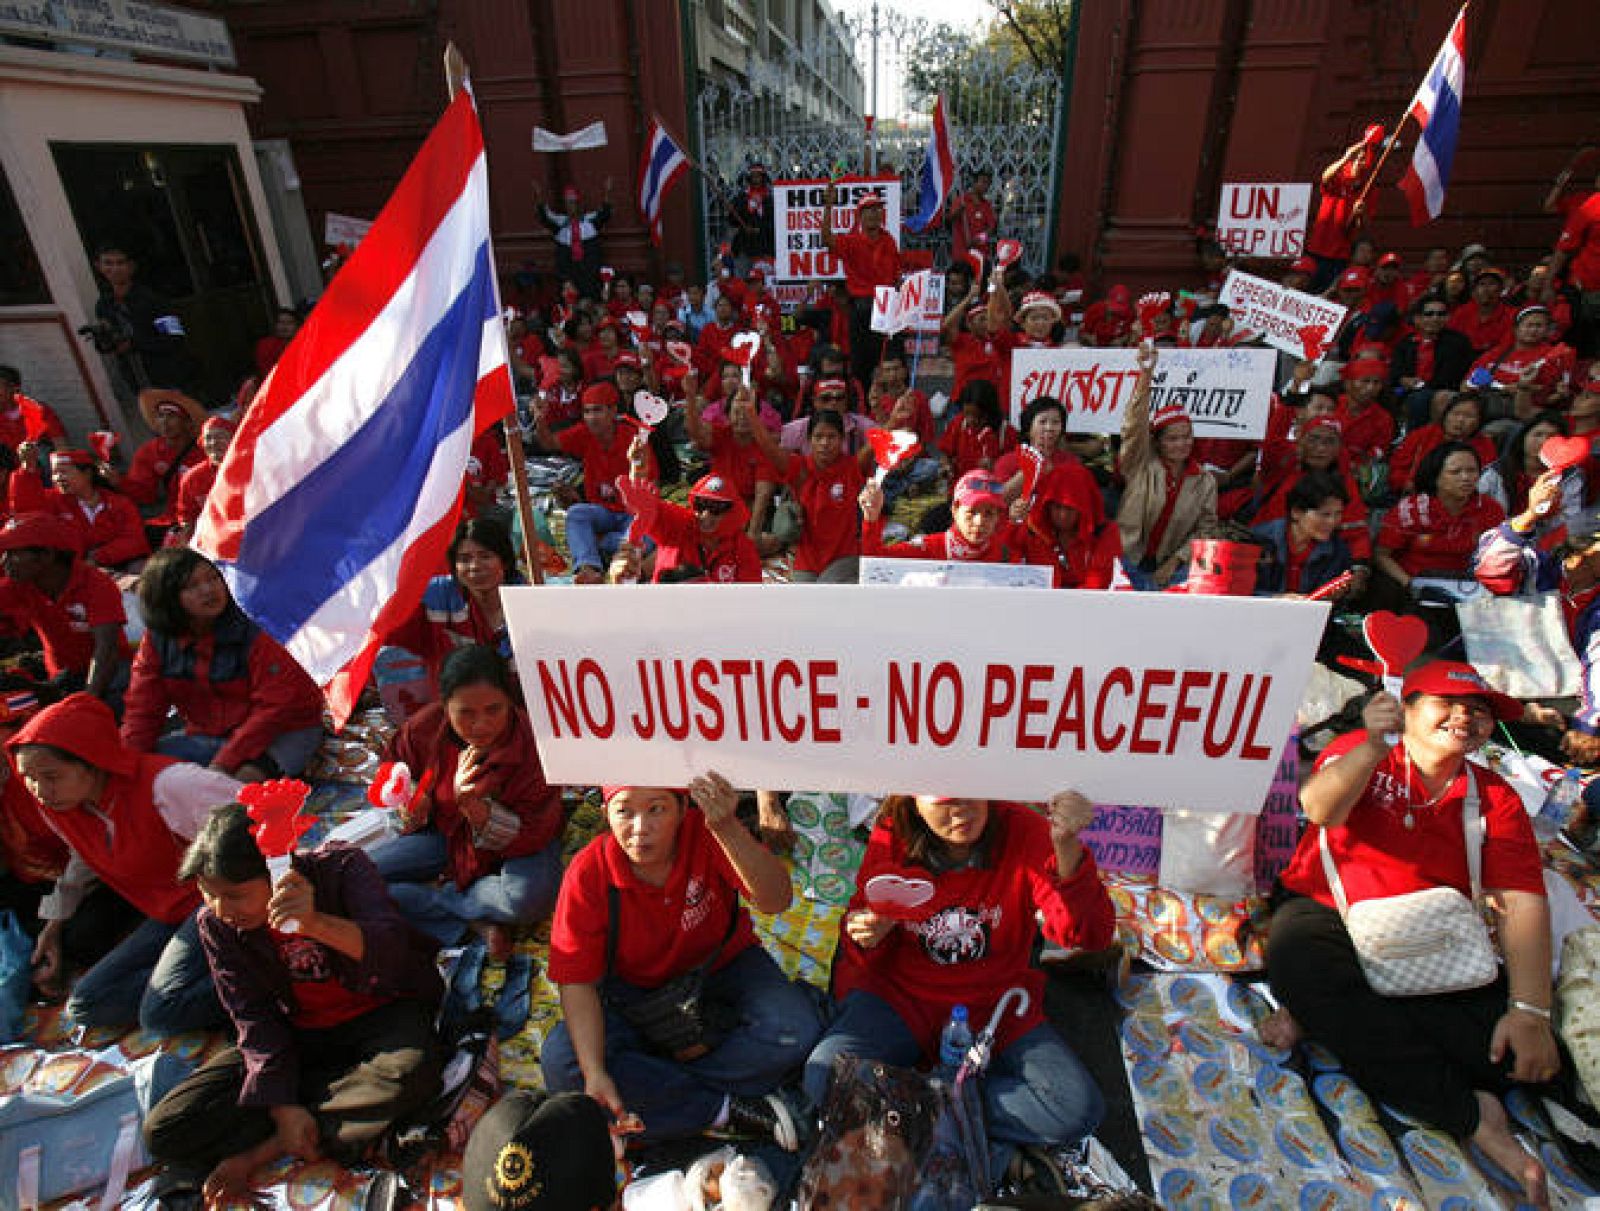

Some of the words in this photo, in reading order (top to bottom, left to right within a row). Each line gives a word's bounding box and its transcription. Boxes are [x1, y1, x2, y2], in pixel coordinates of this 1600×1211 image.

[1229, 187, 1280, 220] UN
[1217, 228, 1266, 255] HELP
[1269, 229, 1305, 256] US
[536, 657, 616, 739] NO
[631, 657, 841, 744] JUSTICE
[856, 697, 870, 709] -
[888, 661, 964, 747] NO
[978, 663, 1273, 761] PEACEFUL
